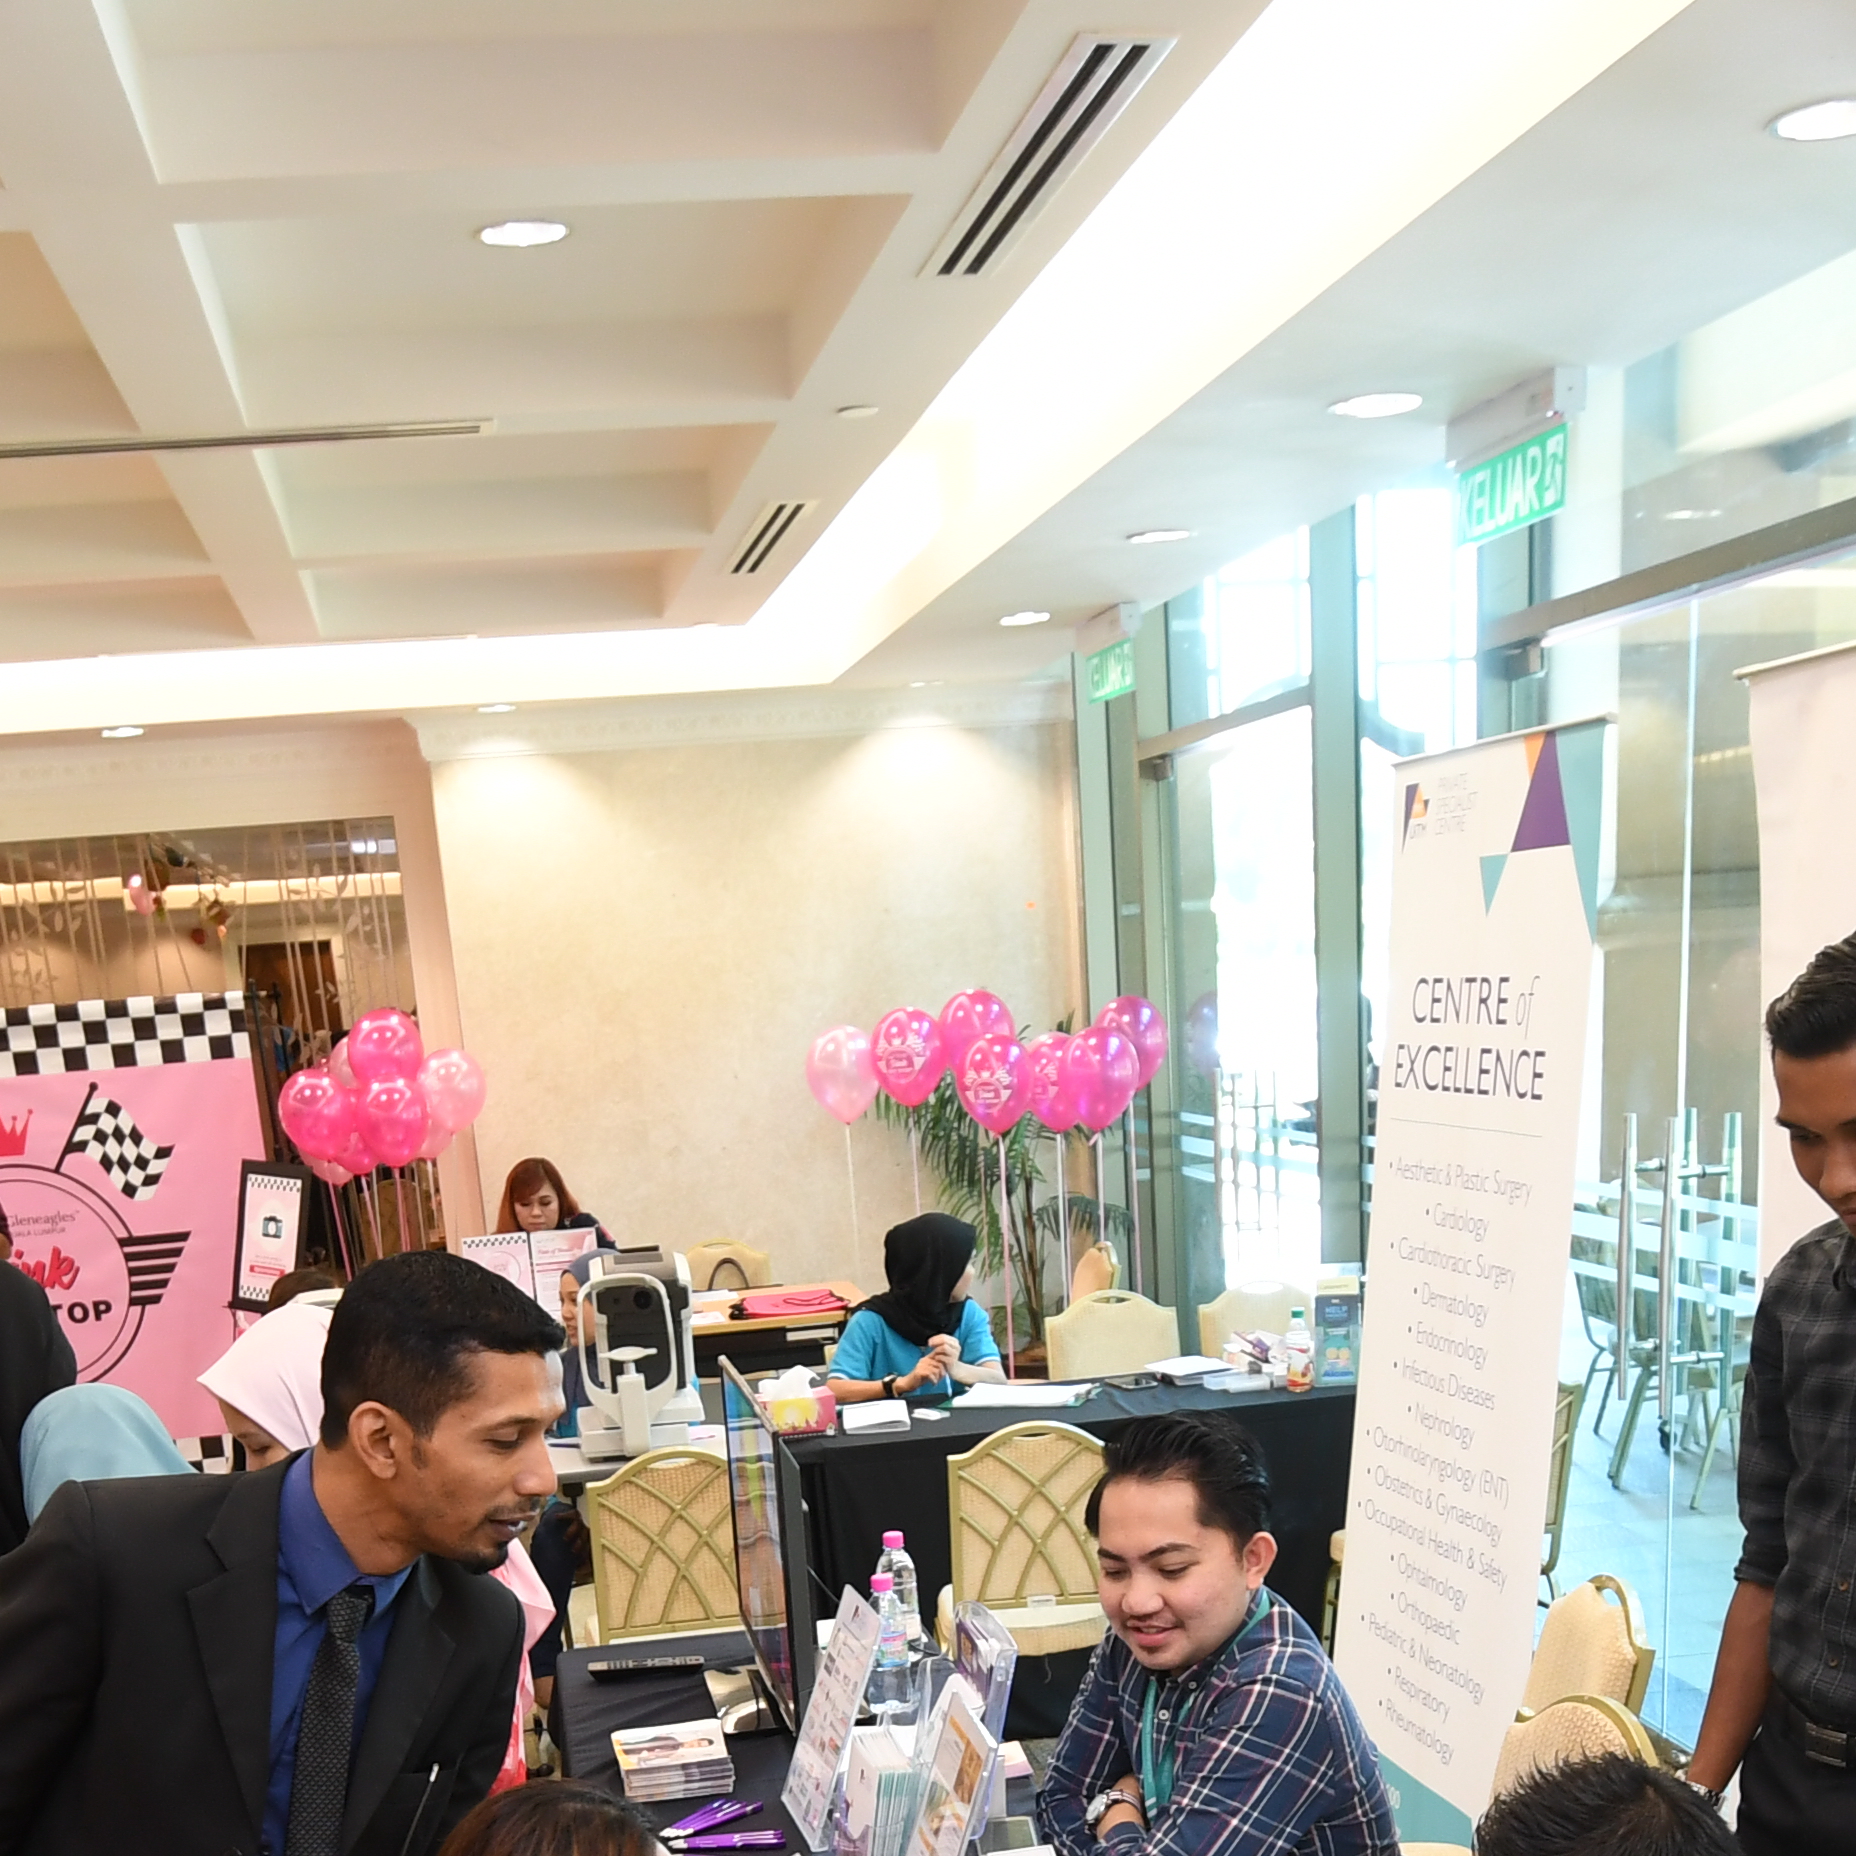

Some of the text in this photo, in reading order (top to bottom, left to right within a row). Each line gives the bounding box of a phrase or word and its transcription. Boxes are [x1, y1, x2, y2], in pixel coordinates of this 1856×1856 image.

[1460, 446, 1543, 541] KELUAR
[1435, 815, 1467, 837] CENTRE
[1411, 975, 1542, 1041] CENTRE of
[1394, 1042, 1547, 1101] EXCELLENCE
[1396, 1157, 1533, 1208] Aesthetic & Plastic Surgery
[1434, 1203, 1490, 1243] Cardiology
[1398, 1237, 1517, 1292] Cardiothoracic Surgery
[50, 1299, 113, 1324] TOP
[1421, 1281, 1489, 1329] Dermatology
[1402, 1356, 1496, 1411] Infectious Diseases
[1414, 1402, 1475, 1450] Nephrology
[1375, 1465, 1503, 1548] Obstetrics & Gynaecology
[1479, 1468, 1510, 1510] (ENT)
[1427, 1528, 1464, 1564] Health
[1466, 1547, 1475, 1570] &
[1479, 1552, 1508, 1595] Safety
[1397, 1591, 1462, 1645] Orthopaedic
[1368, 1612, 1486, 1706] Pediatric & Neonatology
[1395, 1665, 1451, 1724] Respiratory
[1386, 1698, 1455, 1766] Rheumatology
